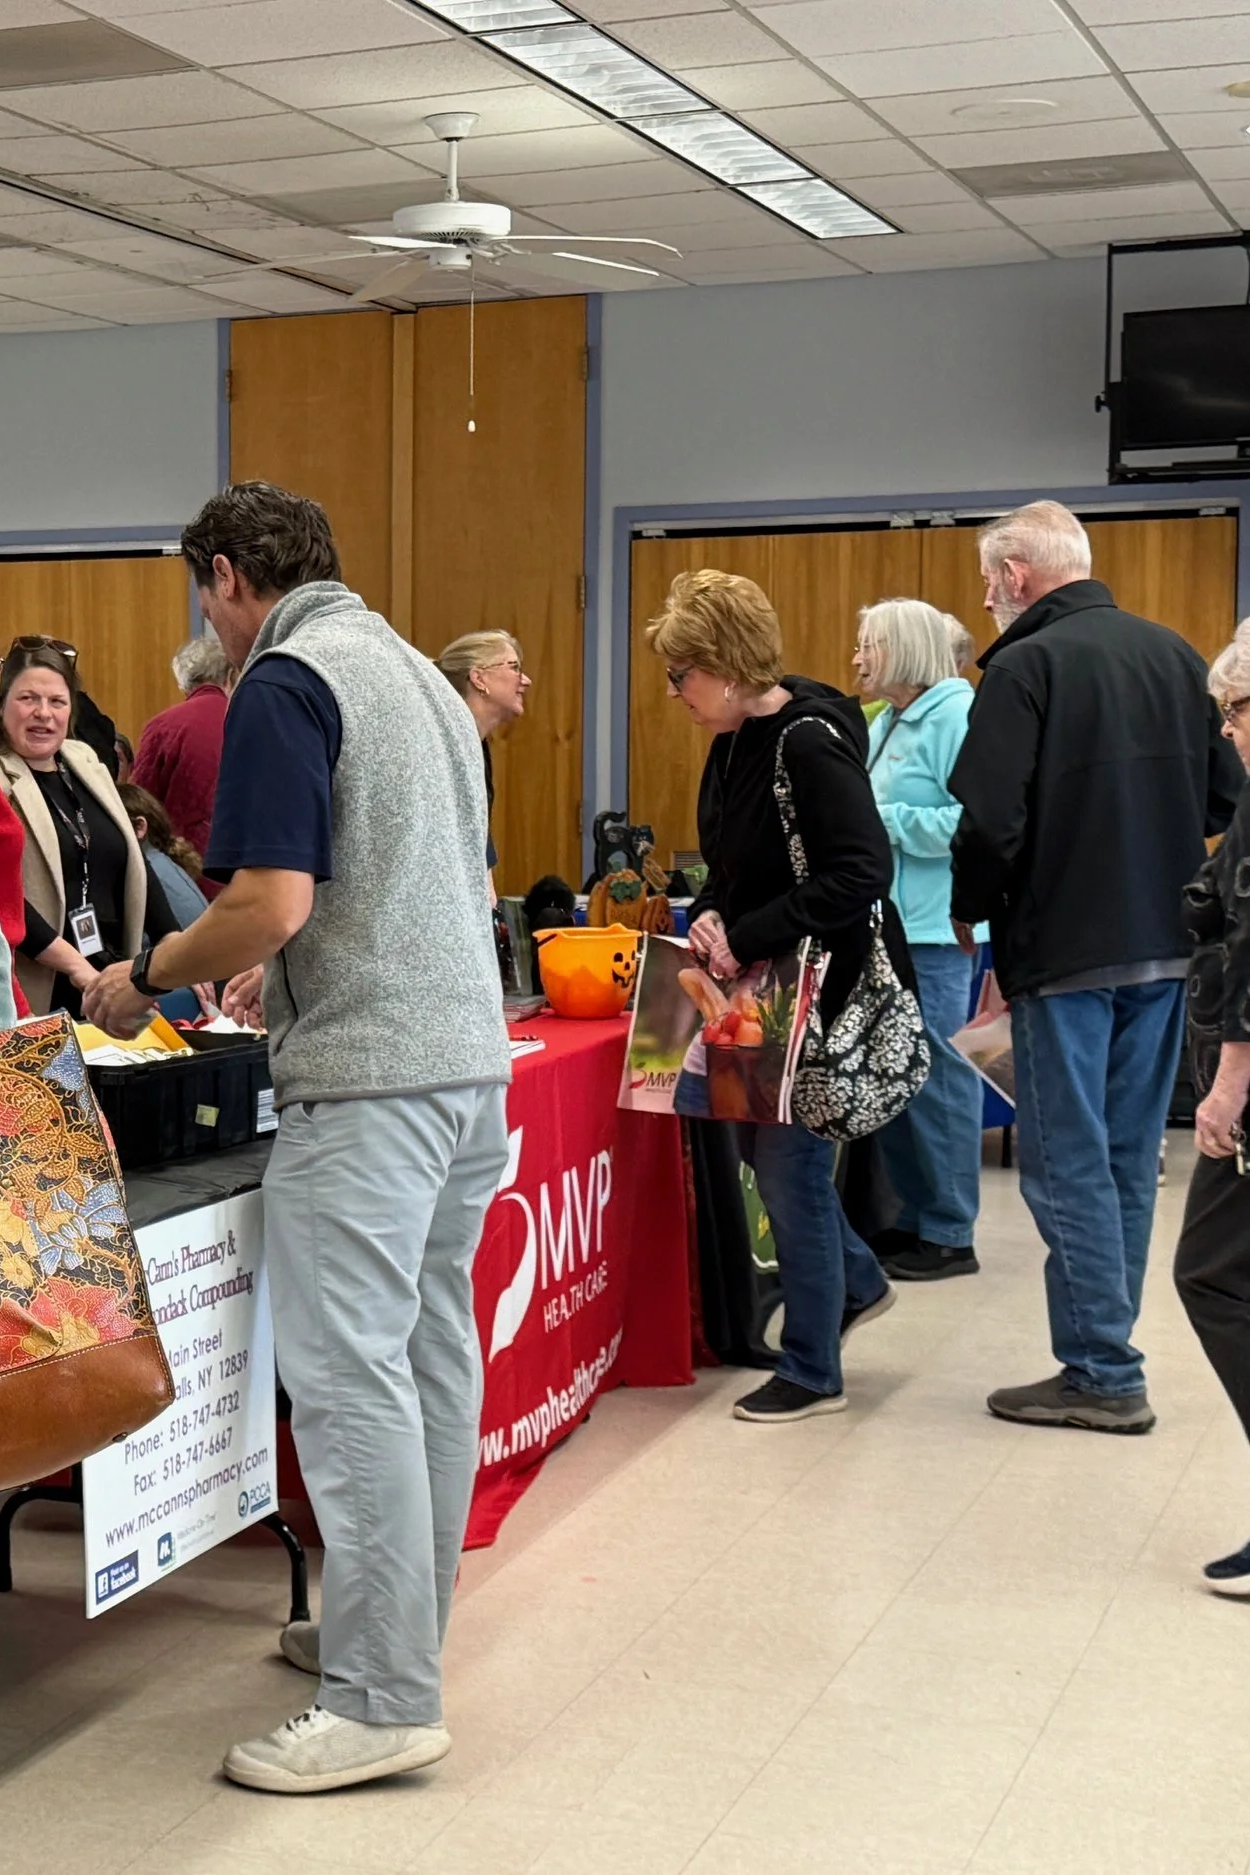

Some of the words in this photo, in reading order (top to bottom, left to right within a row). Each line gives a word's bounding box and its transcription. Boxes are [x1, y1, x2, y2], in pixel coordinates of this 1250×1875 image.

[646, 1071, 676, 1087] MVP
[540, 1149, 612, 1290] MVP
[145, 1250, 179, 1286] Cann's
[181, 1242, 226, 1269] Pharmacy
[227, 1229, 237, 1257] &
[190, 1266, 254, 1312] Compounding
[543, 1276, 586, 1333] HEALTH
[585, 1260, 609, 1303] CARE
[192, 1328, 223, 1360] Street
[198, 1365, 213, 1391] NY
[219, 1349, 249, 1381] 12839
[124, 1431, 164, 1465] Phone:
[169, 1390, 240, 1442] 518-747-4732
[133, 1470, 157, 1496] Fax:
[163, 1426, 233, 1481] 518-747-6667
[105, 1448, 269, 1548] www.mccannspharmacy.com
